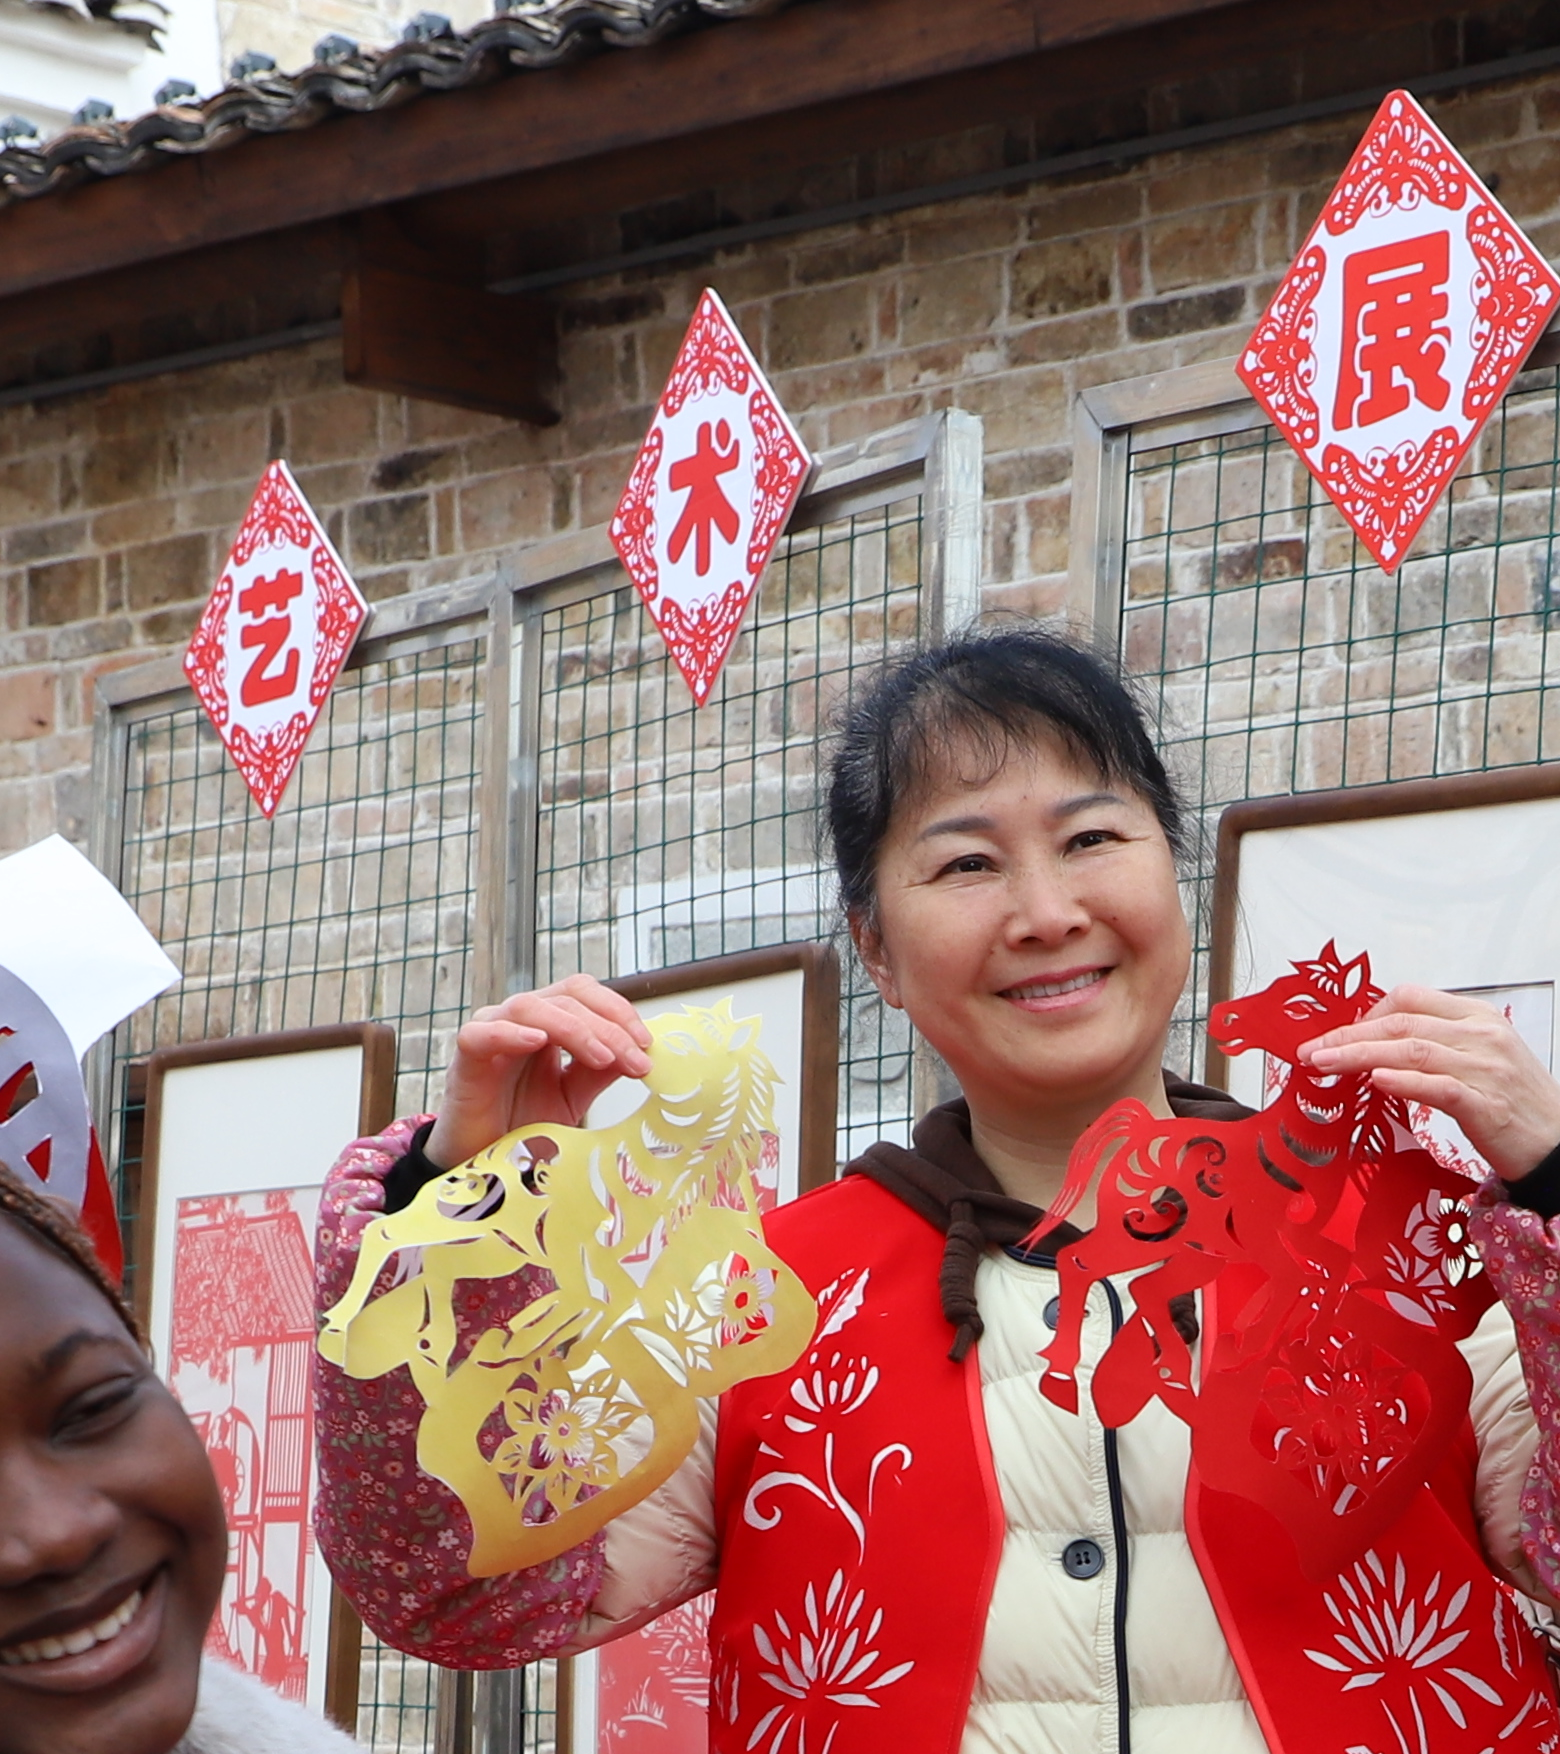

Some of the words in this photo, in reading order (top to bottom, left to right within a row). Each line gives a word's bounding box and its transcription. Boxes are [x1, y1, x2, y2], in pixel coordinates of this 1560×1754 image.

[1332, 230, 1451, 431] 展
[668, 419, 740, 577] 术
[239, 567, 303, 707] 艺
